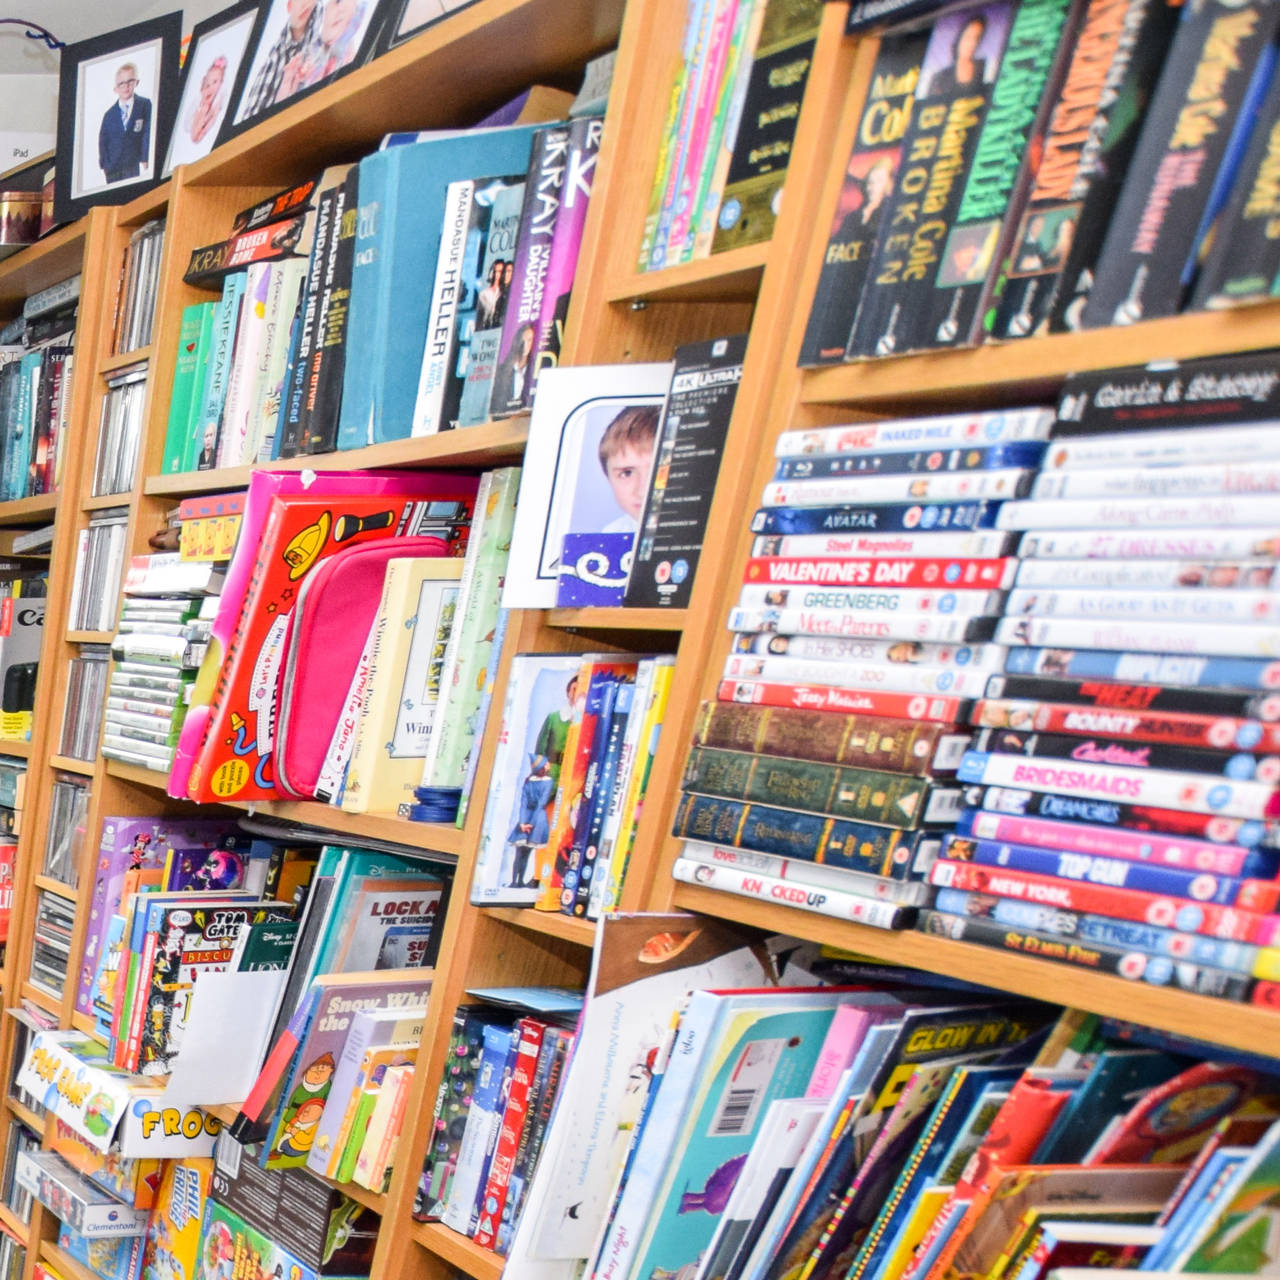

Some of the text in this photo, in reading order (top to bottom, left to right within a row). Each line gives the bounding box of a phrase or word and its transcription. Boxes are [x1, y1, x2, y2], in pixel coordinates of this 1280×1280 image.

[531, 140, 569, 239] KRAY
[309, 199, 333, 292] MANDASUE
[432, 187, 471, 358] MANDASUE HELLER
[518, 243, 542, 324] DAUGHTER
[299, 294, 317, 359] HELLER
[289, 360, 308, 423] two-faced
[823, 514, 877, 529] AVATAR
[769, 561, 916, 583] VALENTINE'S DAY
[803, 591, 900, 611] GREENBERG
[257, 661, 269, 686] Let's
[360, 616, 390, 718] Winnie-the-Pooh
[348, 665, 370, 715] Amelia
[1063, 712, 1140, 734] BOUNTY
[1013, 765, 1145, 797] BRIDESMAIDS
[713, 848, 737, 864] love
[990, 876, 1026, 897] NEW
[371, 901, 419, 917] LOCK
[807, 893, 827, 908] UP
[214, 911, 248, 925] TOM
[380, 916, 435, 926] THE SUICID
[186, 951, 232, 963] BISCU
[328, 991, 430, 1016] Snow Whi
[318, 1015, 350, 1034] the
[904, 1023, 970, 1054] GLOW
[142, 1108, 220, 1140] FROG
[169, 1165, 188, 1226] FRIDGE
[187, 1170, 201, 1218] PHIL
[86, 1221, 137, 1233] Clementoni
[609, 1224, 632, 1257] Night
